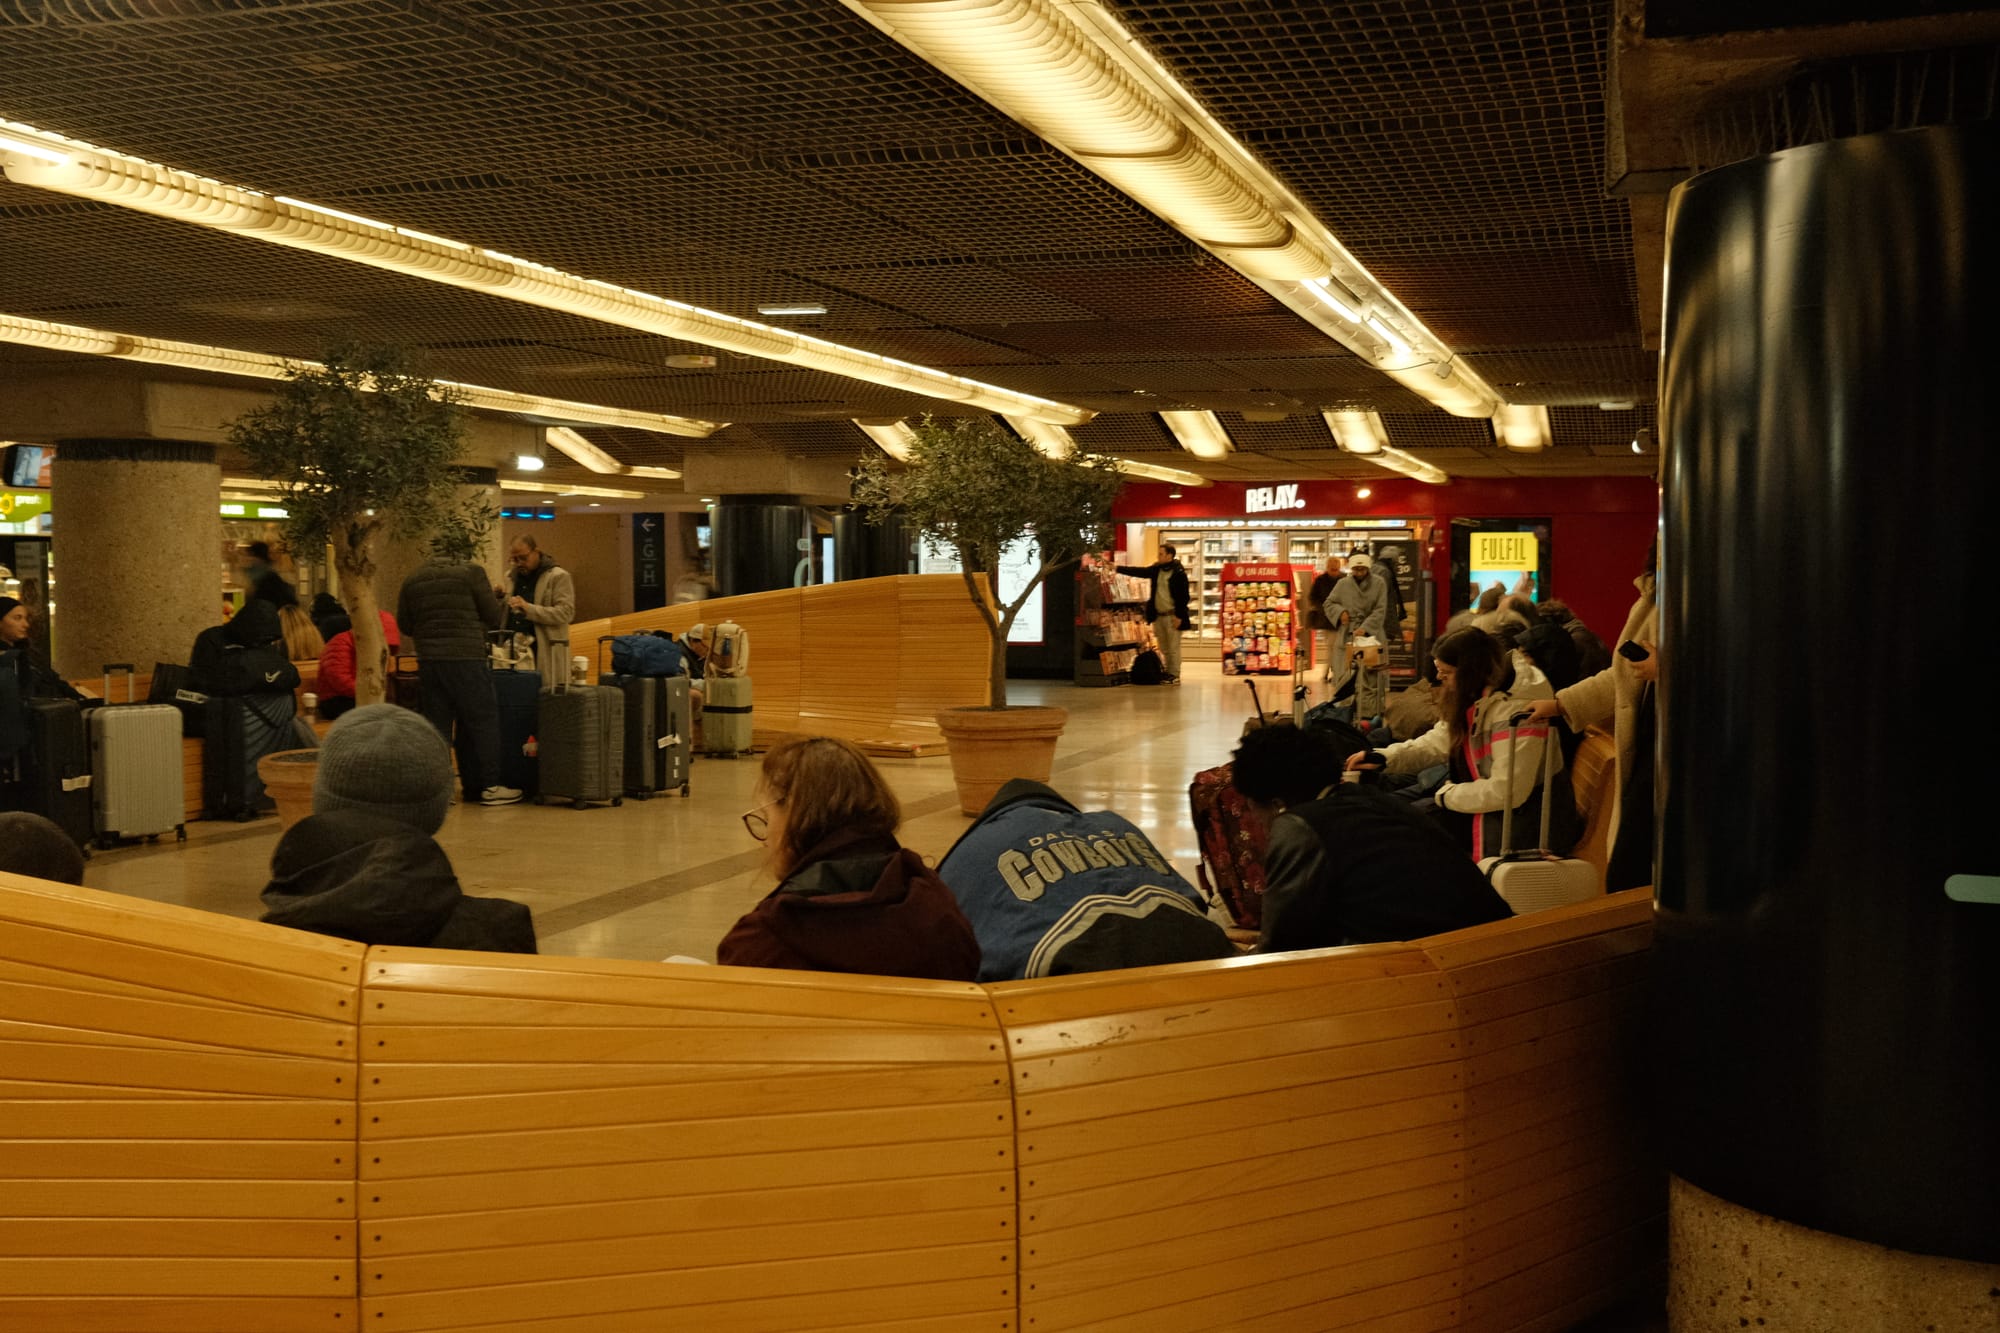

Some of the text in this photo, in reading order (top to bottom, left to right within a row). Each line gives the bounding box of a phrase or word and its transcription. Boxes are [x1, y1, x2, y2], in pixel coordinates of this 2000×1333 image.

[1481, 538, 1527, 561] FULFIL
[1028, 830, 1115, 847] DALLAS
[997, 832, 1170, 902] COWBOYS
